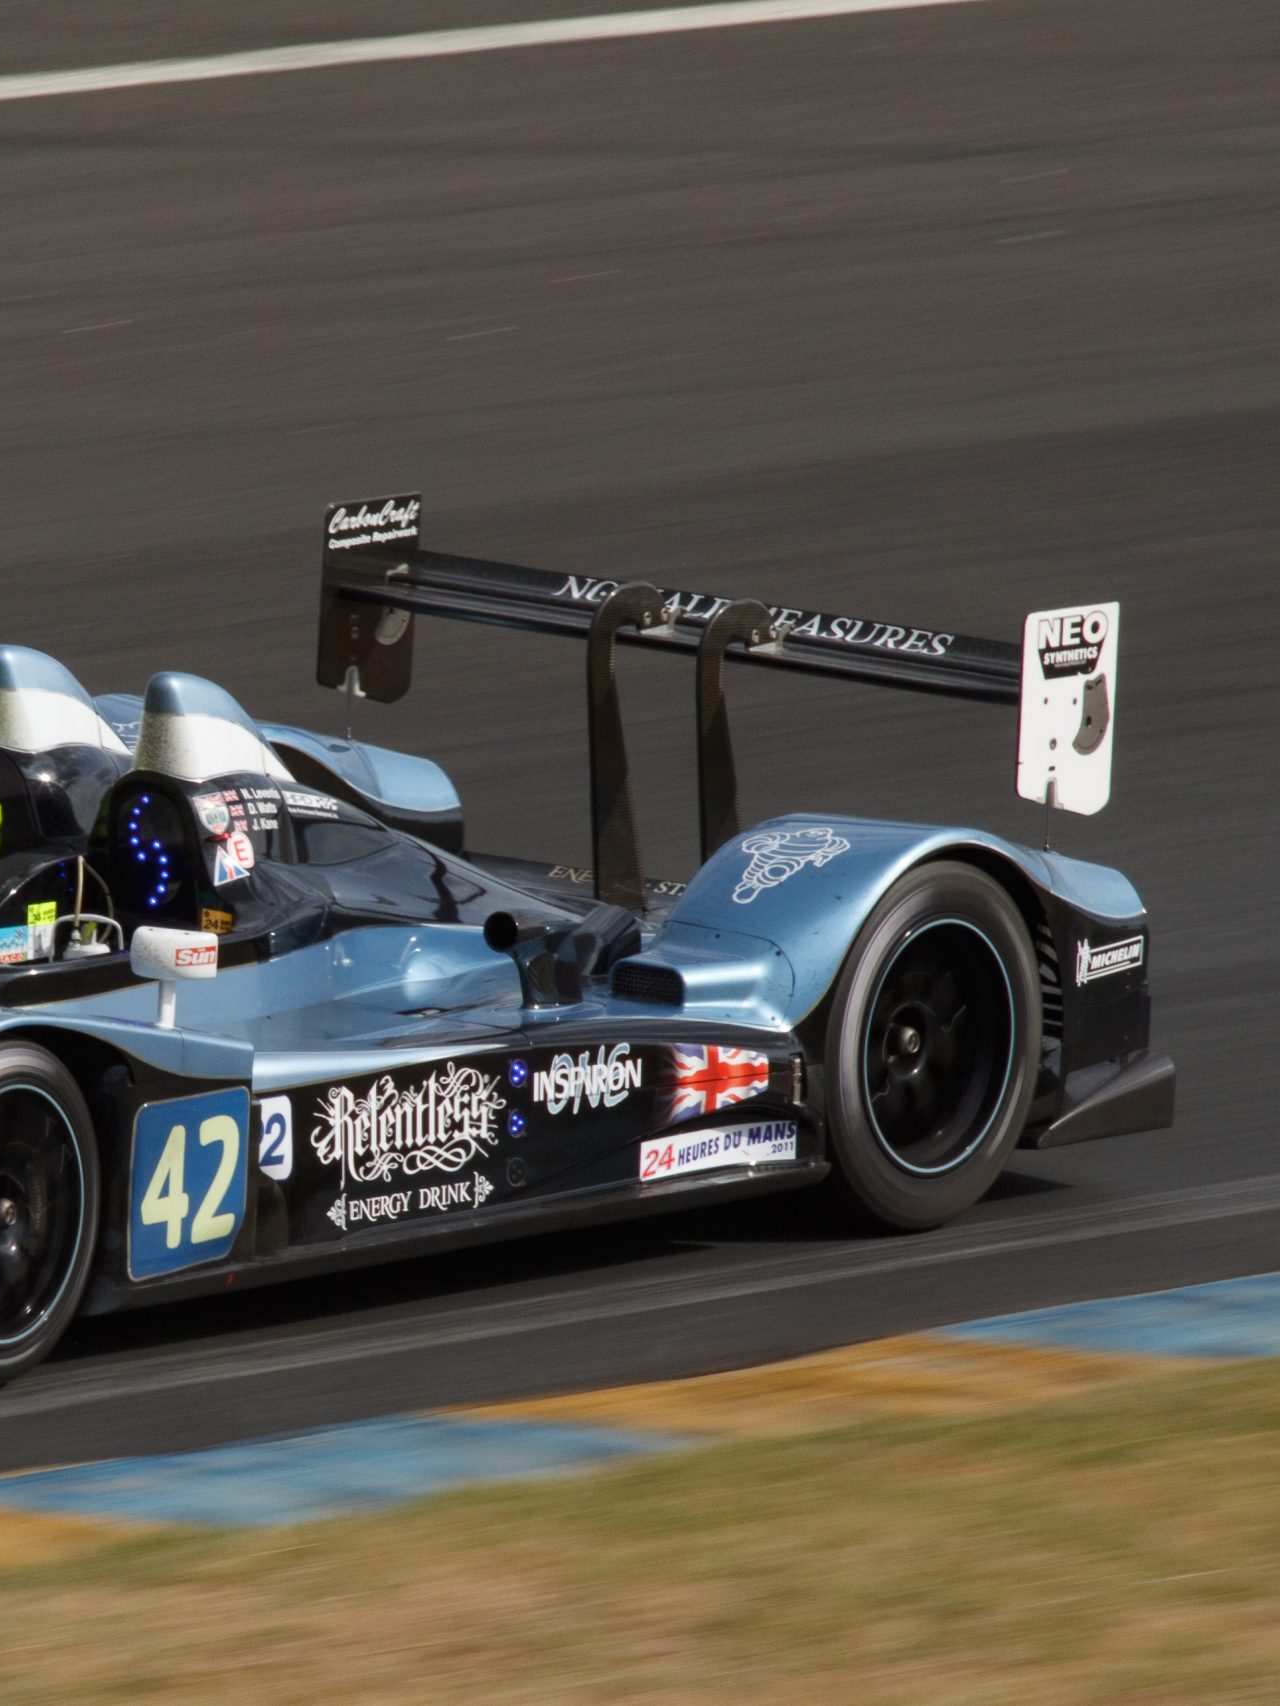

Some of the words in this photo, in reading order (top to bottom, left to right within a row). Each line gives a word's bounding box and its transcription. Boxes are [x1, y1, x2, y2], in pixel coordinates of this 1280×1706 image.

[768, 605, 956, 657] EASURES
[1038, 610, 1109, 649] NEO
[1043, 646, 1099, 666] SYNTHETICS
[176, 949, 216, 965] Sun
[1090, 943, 1142, 970] MICHELIN
[533, 1058, 642, 1102] INSPIRON
[314, 1064, 502, 1184] Relentless
[642, 1143, 676, 1178] 24
[677, 1136, 720, 1166] HEURES
[724, 1130, 743, 1151] DU
[747, 1121, 796, 1147] MANS
[771, 1141, 795, 1154] 2011
[140, 1115, 240, 1249] 42
[349, 1190, 413, 1222] ENERGY
[419, 1181, 472, 1211] DRINK
